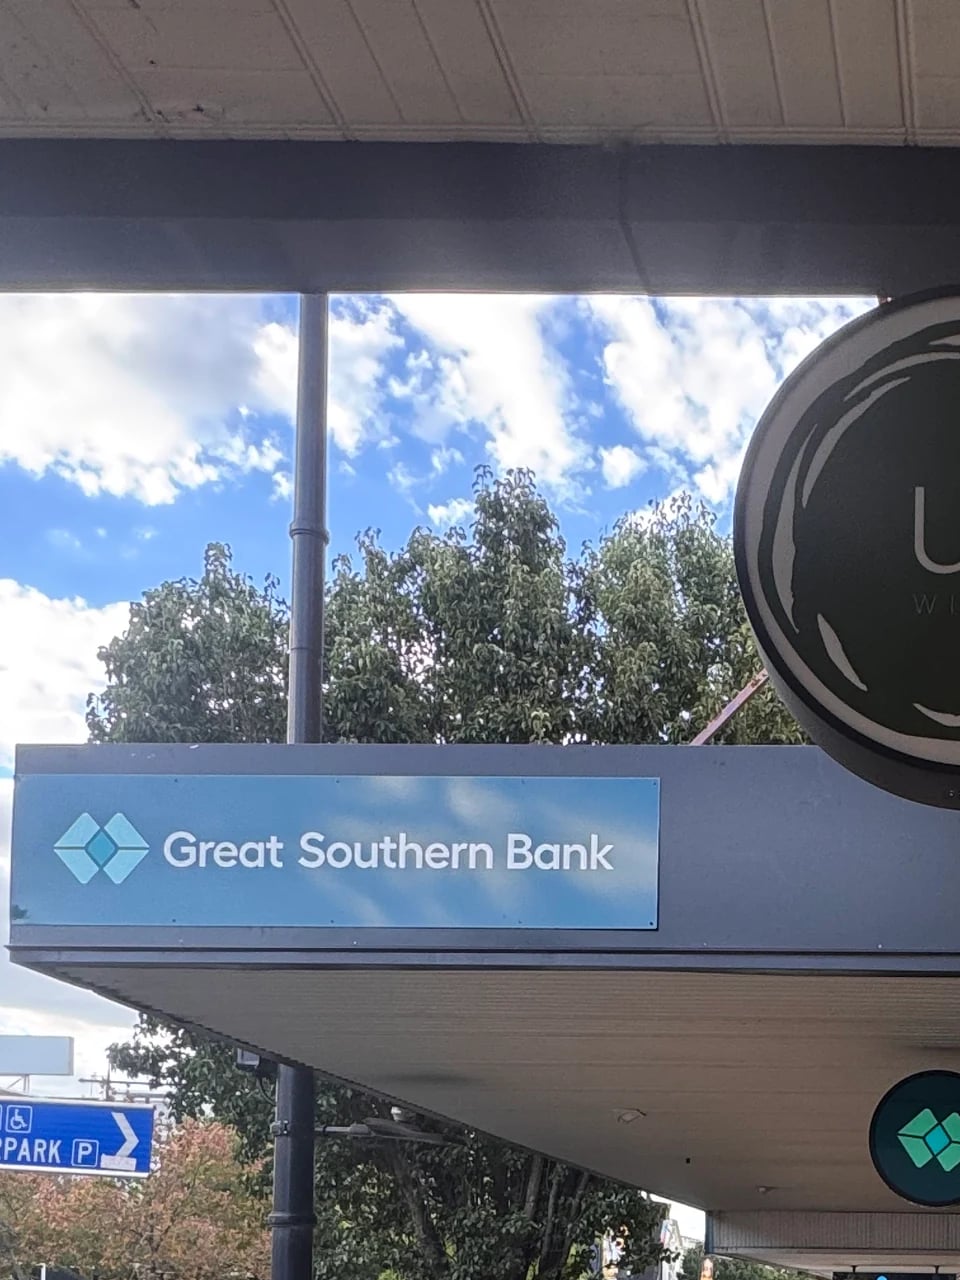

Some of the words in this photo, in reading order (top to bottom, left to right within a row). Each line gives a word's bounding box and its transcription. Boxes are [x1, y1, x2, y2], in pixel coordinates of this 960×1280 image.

[163, 829, 284, 870] Great
[297, 830, 495, 871] Southern
[506, 833, 615, 871] Bank
